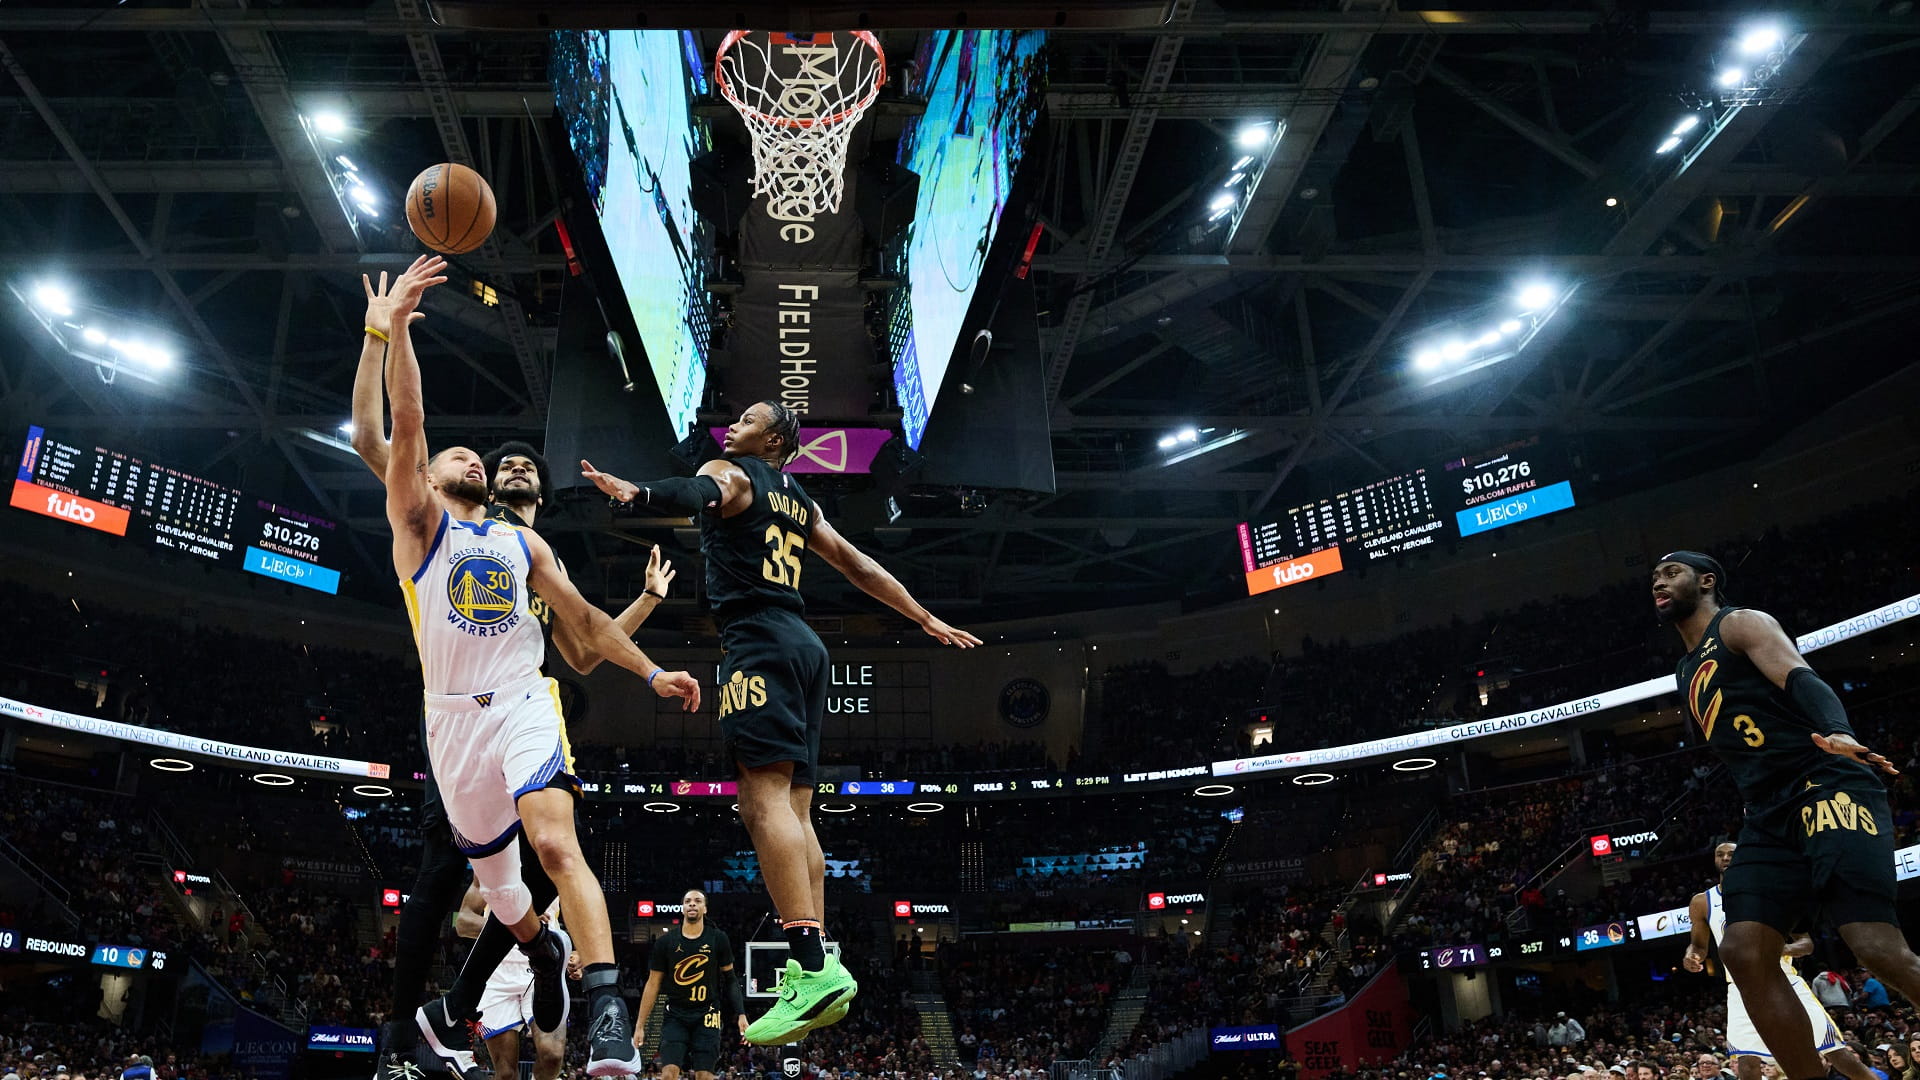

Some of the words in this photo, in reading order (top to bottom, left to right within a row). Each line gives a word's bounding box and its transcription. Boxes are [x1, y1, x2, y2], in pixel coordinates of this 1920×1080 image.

[767, 47, 837, 243] Mogage
[683, 344, 699, 409] CLIFFS
[49, 472, 66, 482] Curry
[1462, 461, 1531, 495] $10,276
[47, 493, 96, 523] fubo
[767, 491, 807, 526] OKORO
[155, 523, 196, 540] CLEVELAND
[196, 534, 234, 551] CAVALIERS
[263, 521, 320, 551] $10,276
[1364, 532, 1404, 549] CLEVELAND
[1404, 520, 1443, 537] CAVALIERS
[178, 541, 189, 551] TY
[1369, 549, 1389, 560] BALL.
[1391, 544, 1401, 553] TY
[1402, 535, 1434, 550] JEROME.
[448, 547, 485, 565] GOLDEN
[490, 549, 517, 569] STATE
[763, 524, 804, 591] 35
[486, 571, 510, 590] 30
[1272, 562, 1314, 585] fubo
[447, 610, 520, 637] WARRIORS
[1797, 629, 1836, 652] ROUD
[1838, 605, 1904, 638] PARTNER
[718, 671, 767, 718] AVS
[0, 702, 24, 713] yBank
[51, 713, 96, 731] PROUD
[98, 724, 156, 745] PARTNER
[157, 736, 171, 746] OF
[177, 738, 200, 752] THE
[201, 742, 271, 764] CLEVELAND
[274, 754, 340, 771] CAVALIERS
[1252, 758, 1283, 768] KeyBank
[1309, 750, 1350, 763] PROUD
[1353, 742, 1401, 758] PARTNER
[1406, 738, 1423, 748] OF
[1426, 730, 1449, 745] THE
[1451, 716, 1527, 739] CLEVELAND
[1530, 698, 1601, 724] CAVALIERS
[1733, 715, 1765, 748] 3
[582, 784, 598, 792] ULS
[604, 784, 612, 793] 2
[650, 784, 664, 793] 74
[709, 783, 722, 793] 71
[818, 783, 835, 794] 2Q
[881, 783, 895, 793] 36
[945, 784, 958, 793] 40
[974, 783, 1004, 792] FOULS
[1009, 781, 1017, 791] 3
[1031, 780, 1050, 789] TOL
[1055, 778, 1063, 789] 4
[1076, 777, 1094, 786] 8:29
[1095, 776, 1110, 785] PM
[1801, 791, 1879, 837] CAVS
[1612, 830, 1659, 848] TOYOTA
[297, 860, 361, 873] WESTFIELD
[1236, 859, 1302, 872] WESTFIELD
[1894, 852, 1918, 874] HE
[187, 874, 211, 884] TOYOTA
[1387, 872, 1412, 882] TOYOTA
[656, 904, 684, 913] TOYOT
[1166, 893, 1205, 905] TOYOTA
[912, 905, 950, 914] TOYOTA
[25, 937, 87, 957] REBOUNDS
[101, 947, 119, 963] 10
[1422, 960, 1430, 969] 2
[1459, 948, 1476, 963] 71
[1520, 941, 1543, 954] 3:57
[1583, 929, 1600, 945] 36
[1628, 928, 1636, 939] 3
[152, 959, 164, 970] 40
[689, 985, 707, 1002] 10
[703, 1010, 721, 1029] CA
[1366, 1009, 1393, 1029] SEAT
[345, 1035, 373, 1045] ULTRA
[1246, 1032, 1276, 1042] ULTRA
[234, 1041, 297, 1055] LECOM
[1304, 1041, 1339, 1055] SEAT
[784, 1062, 799, 1074] ups
[1304, 1056, 1343, 1070] GEEK
